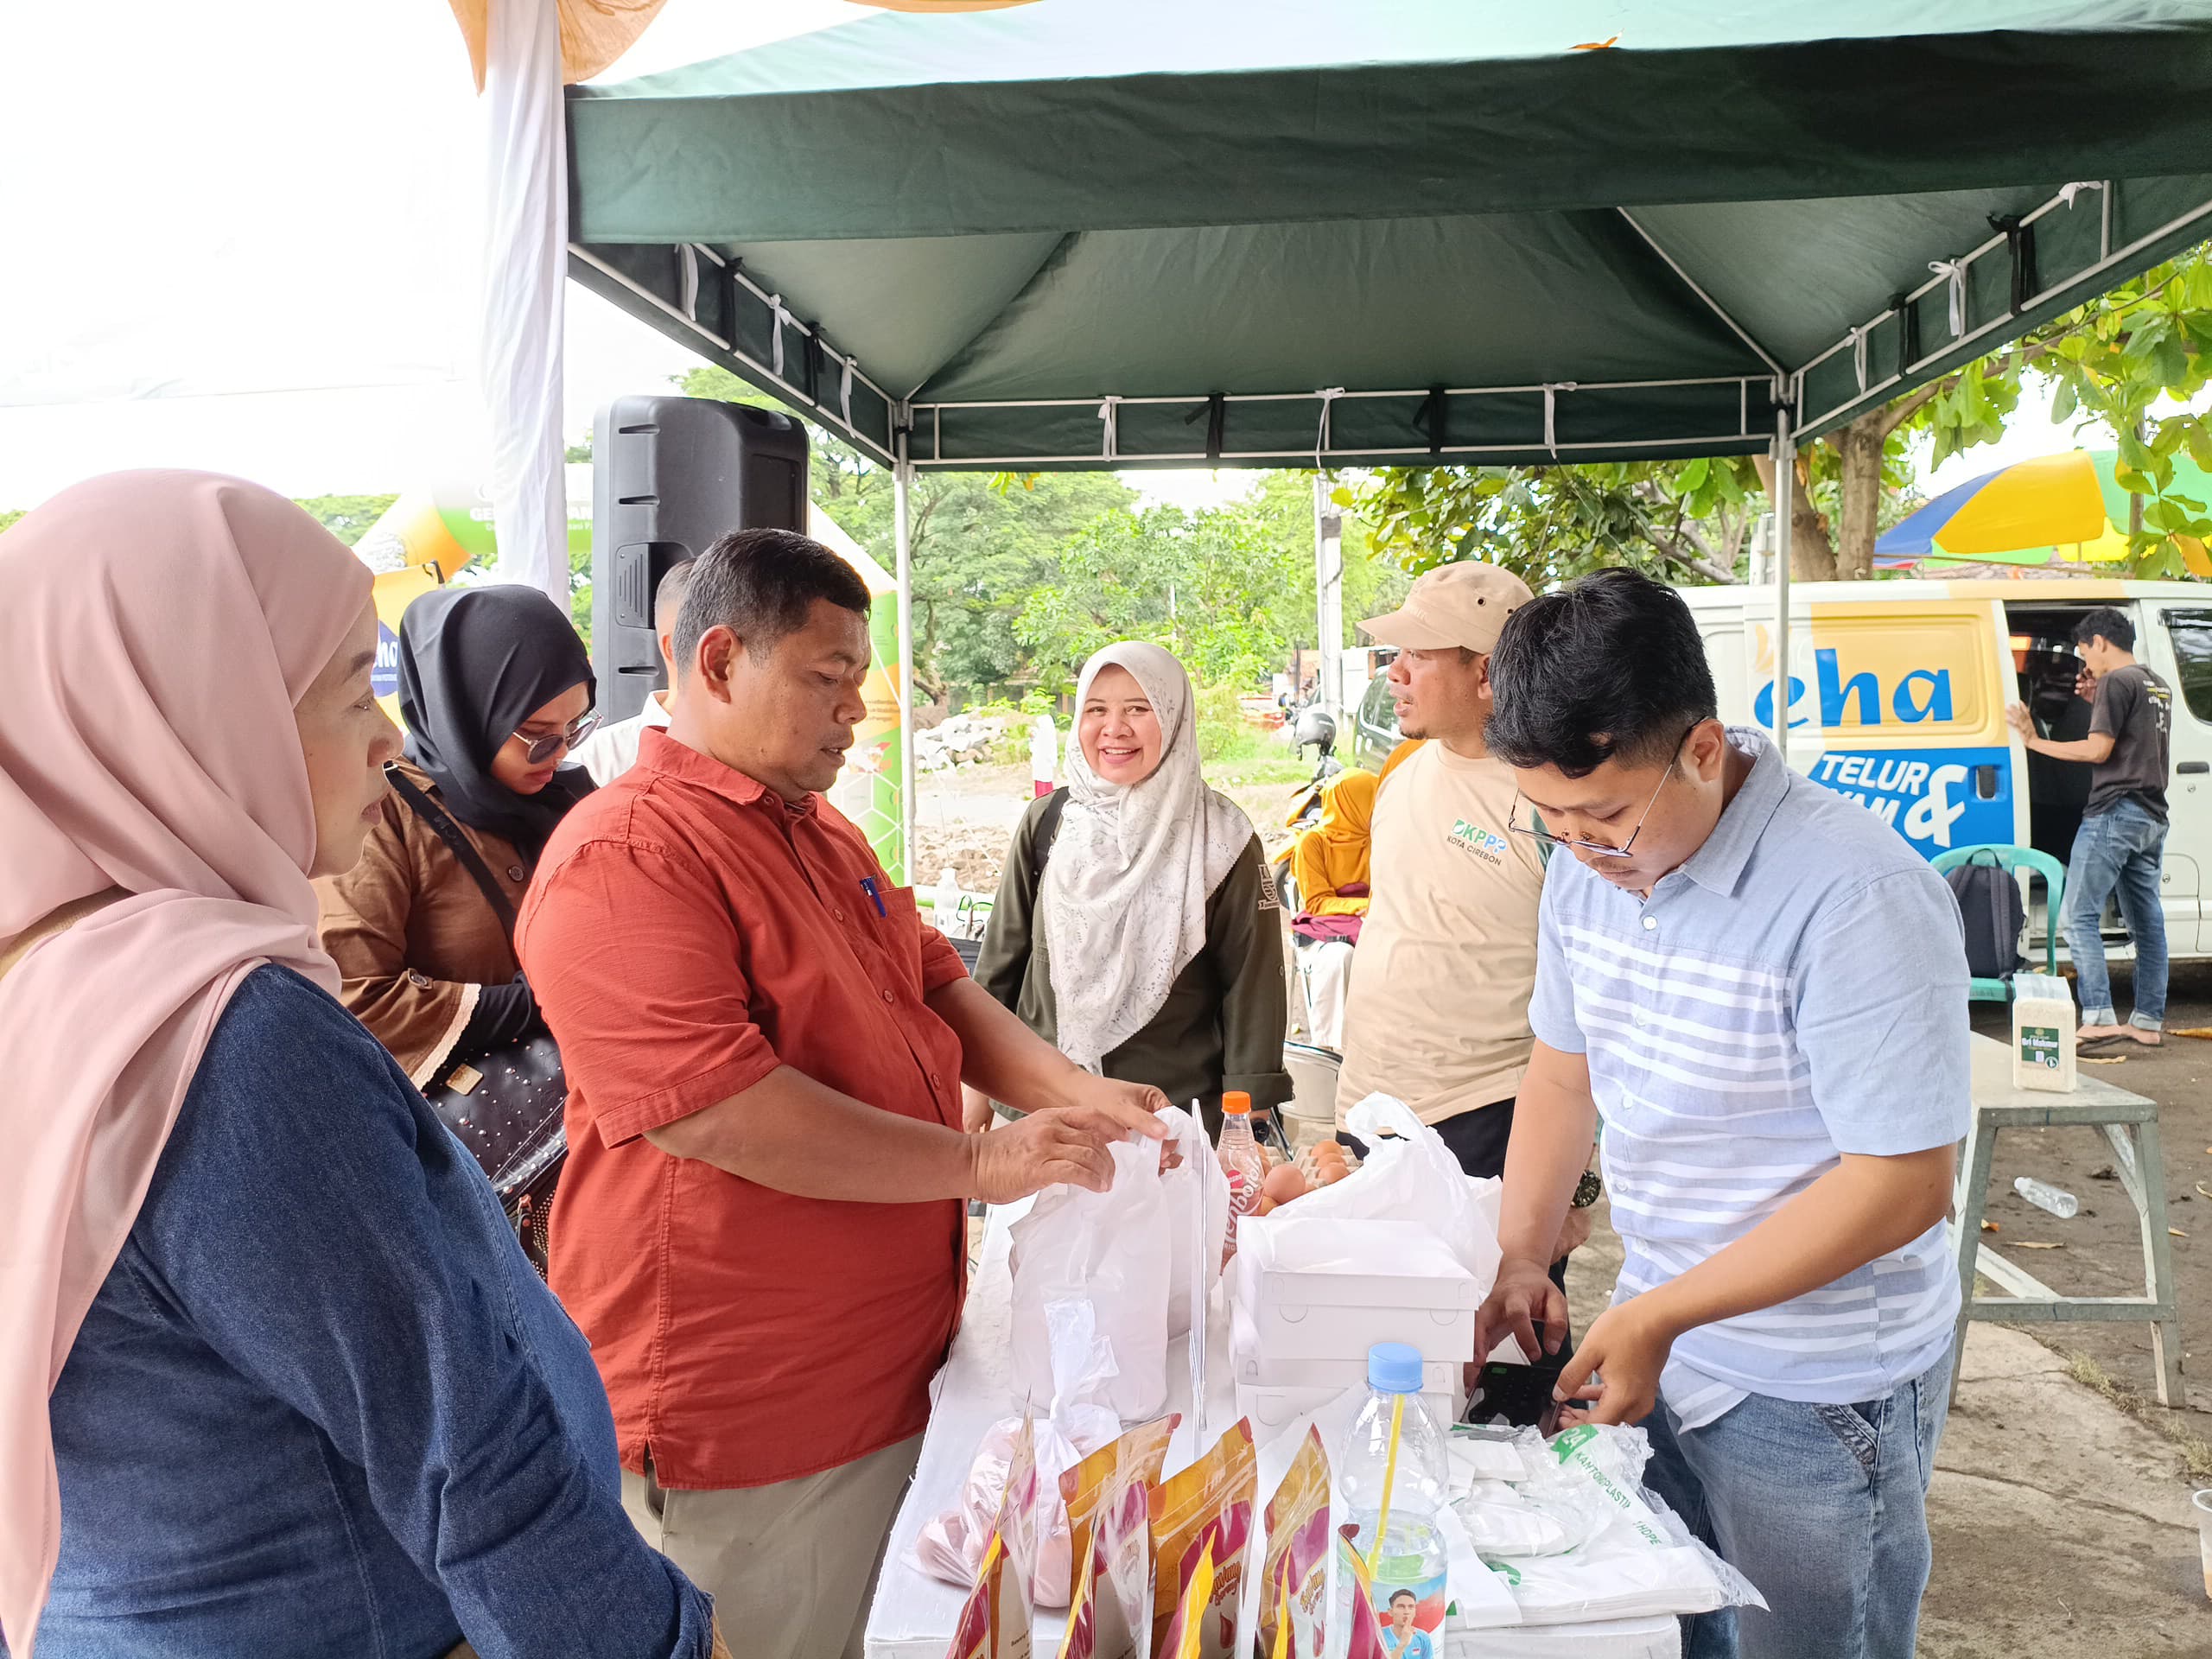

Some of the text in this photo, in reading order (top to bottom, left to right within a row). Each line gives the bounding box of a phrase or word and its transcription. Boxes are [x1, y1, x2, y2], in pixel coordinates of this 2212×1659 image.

[1820, 754, 1929, 796] TELUR
[1446, 836, 1502, 866] KOTA CIREBON
[1561, 1427, 1588, 1450] 24
